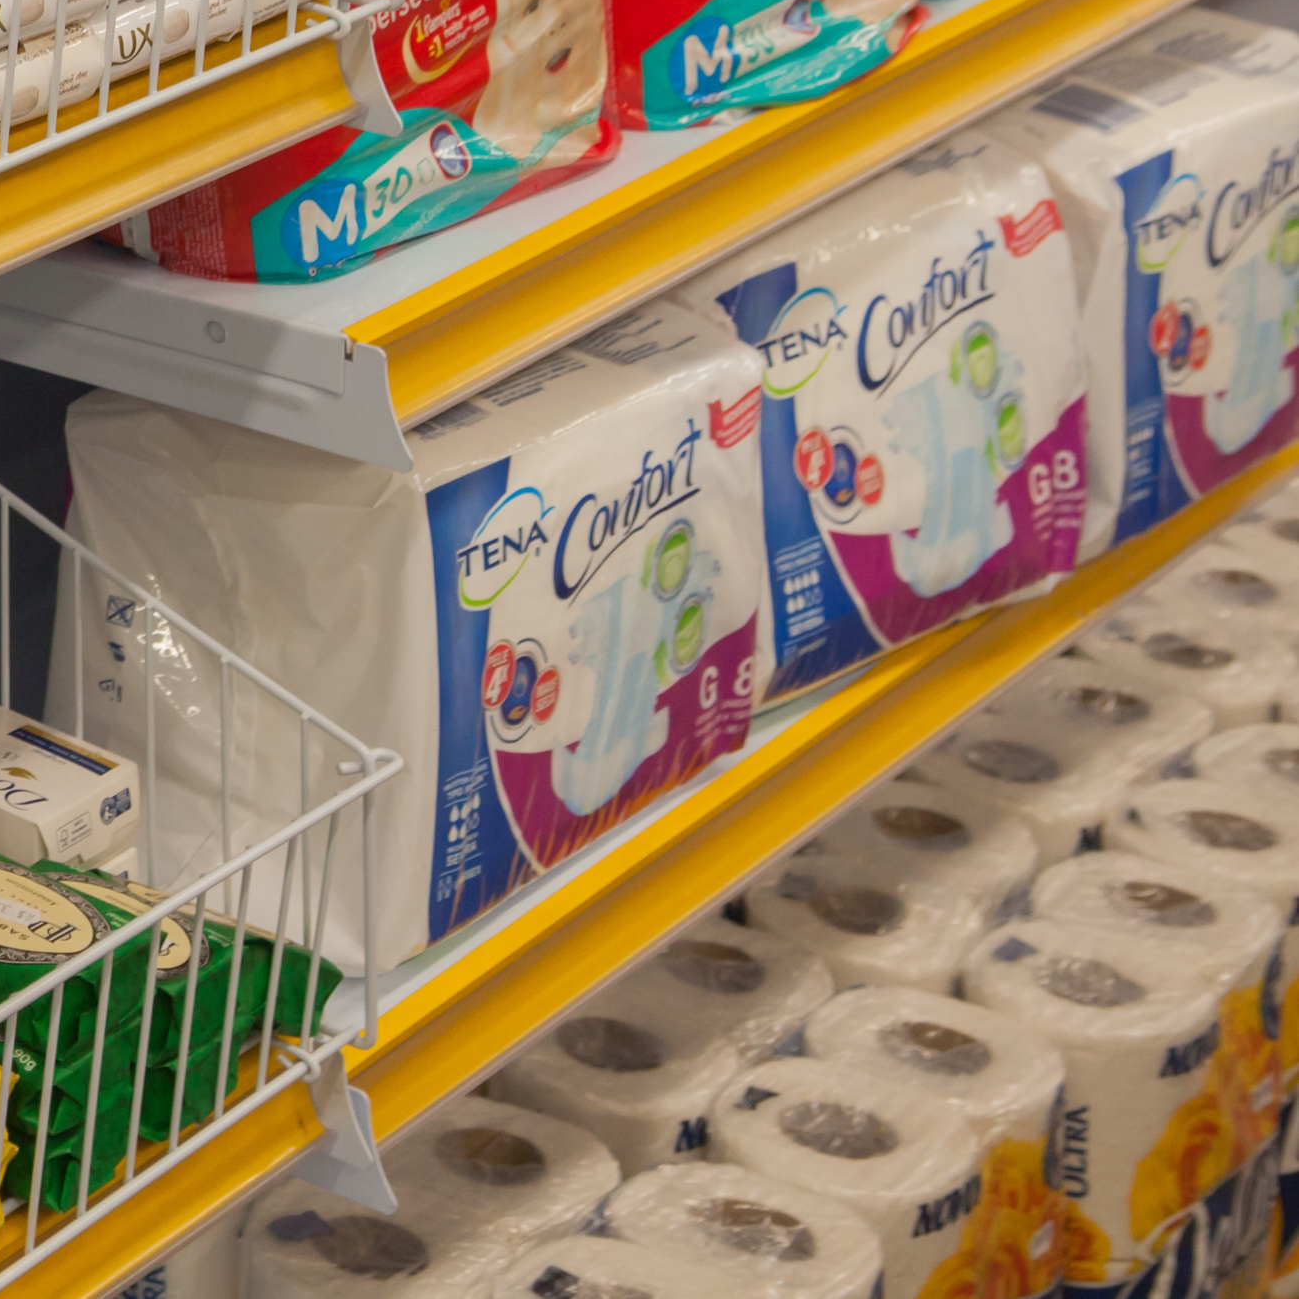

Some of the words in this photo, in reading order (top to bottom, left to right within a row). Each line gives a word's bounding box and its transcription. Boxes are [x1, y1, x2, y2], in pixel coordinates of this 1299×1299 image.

[683, 25, 732, 96] M
[300, 185, 358, 263] M
[366, 164, 411, 219] 30
[757, 318, 849, 370] TENA
[857, 229, 996, 396] Confort
[552, 418, 702, 604] Confort
[457, 522, 549, 578] TENA
[1061, 1105, 1090, 1198] ULTRA
